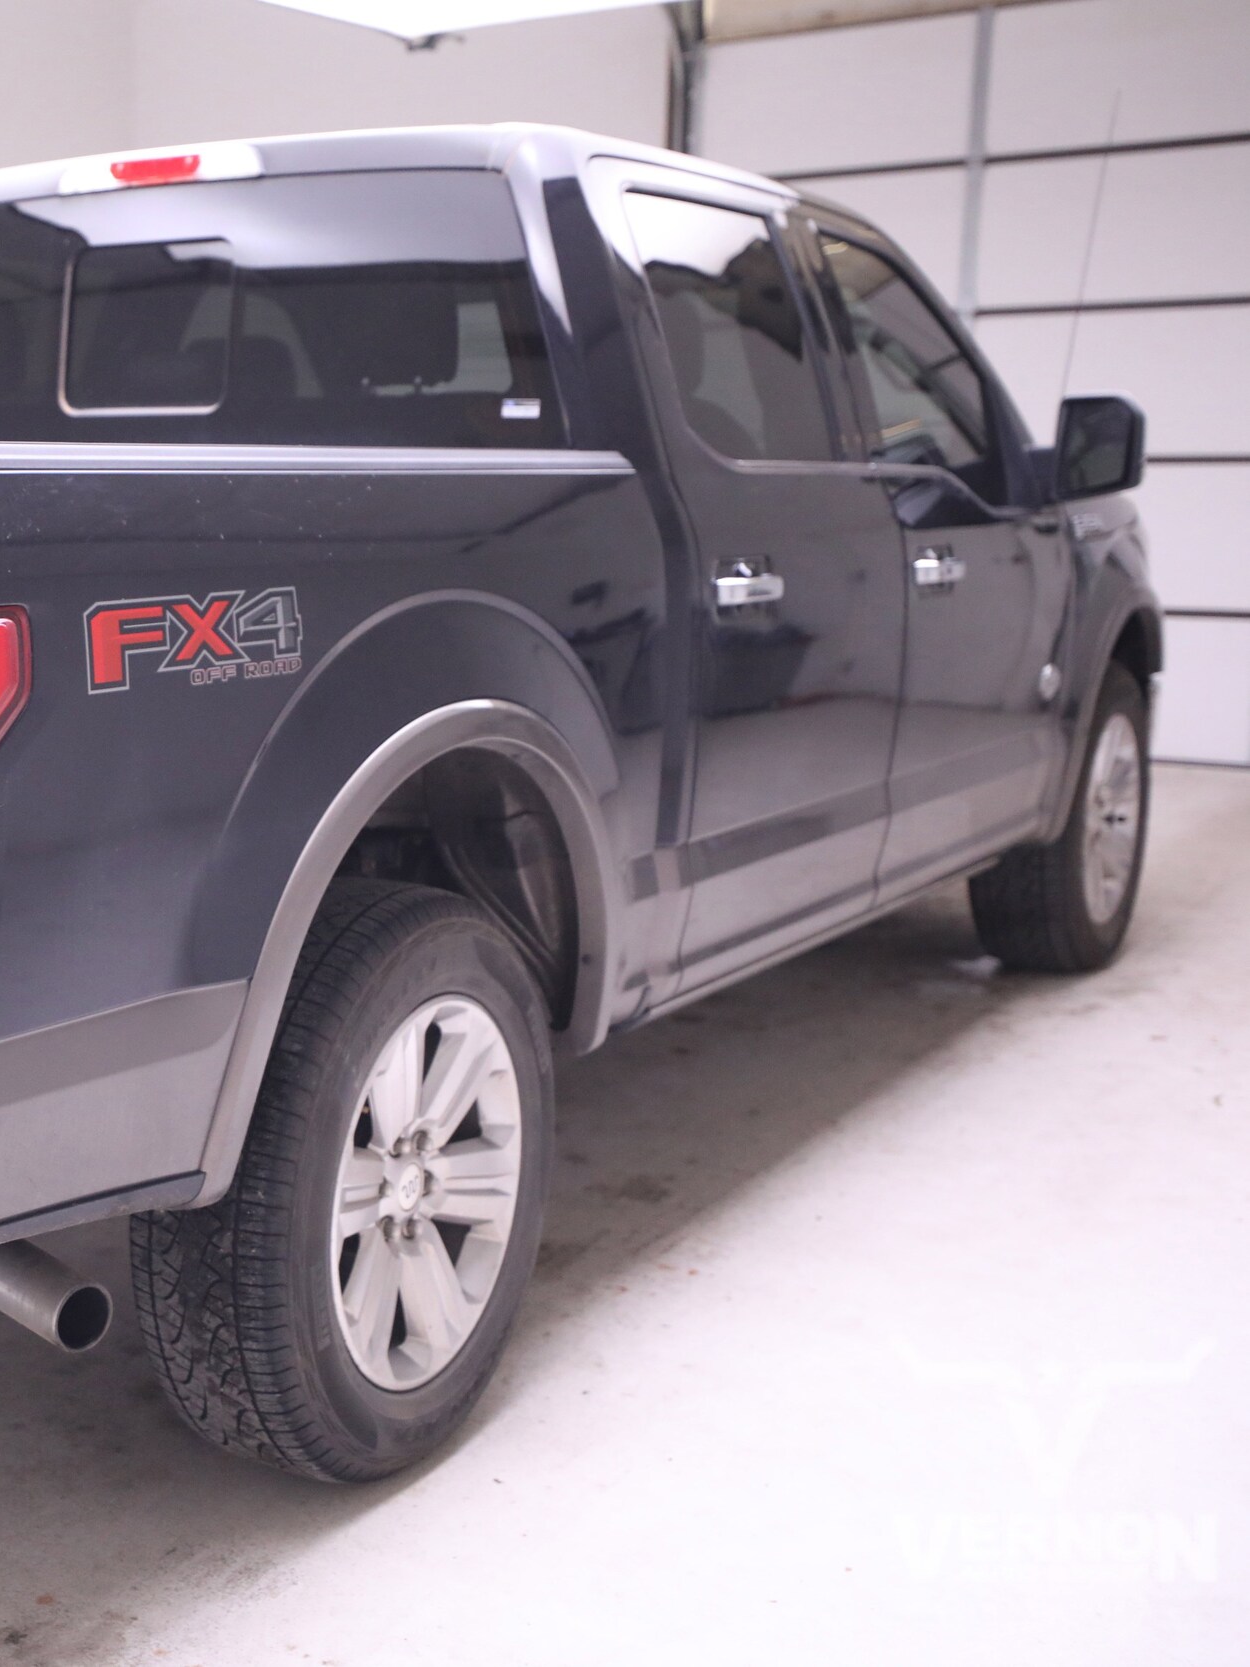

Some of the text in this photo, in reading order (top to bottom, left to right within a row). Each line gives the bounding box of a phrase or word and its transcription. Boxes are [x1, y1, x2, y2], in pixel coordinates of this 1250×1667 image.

[83, 586, 302, 695] FX4
[190, 657, 302, 685] OFF ROAD
